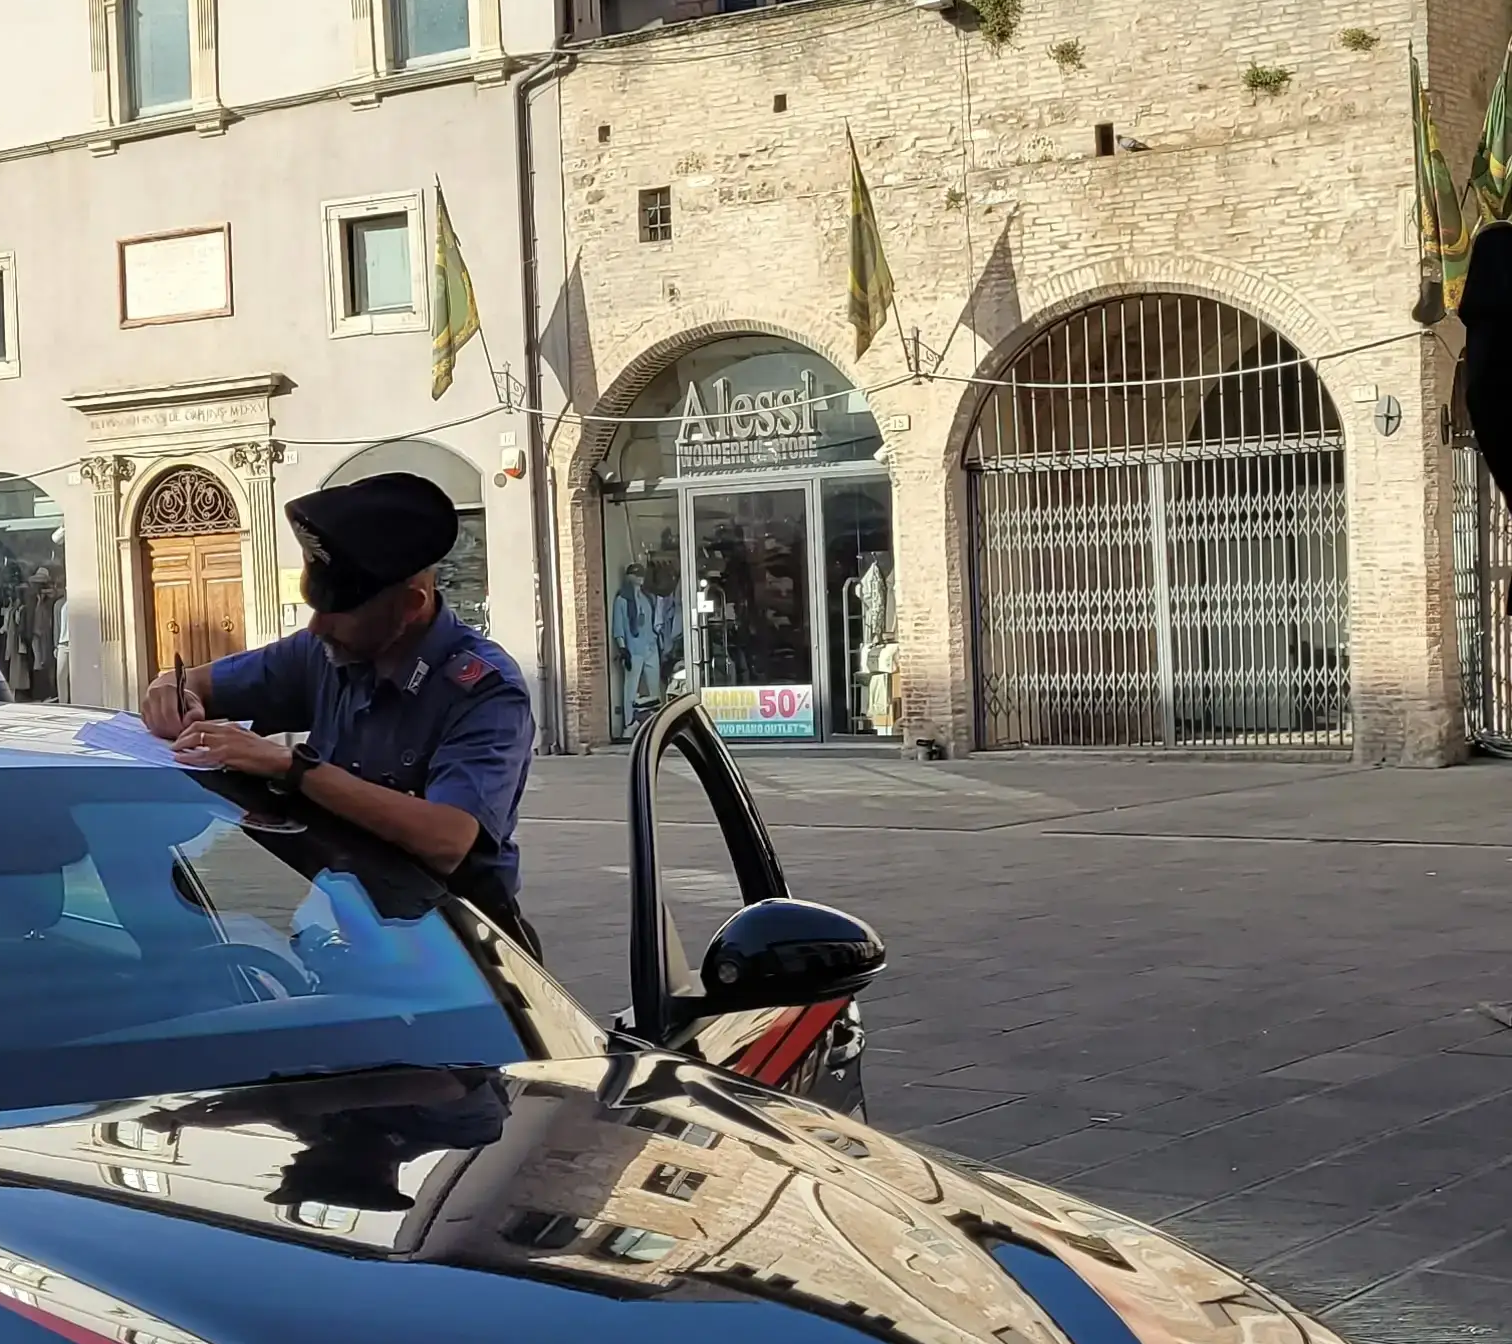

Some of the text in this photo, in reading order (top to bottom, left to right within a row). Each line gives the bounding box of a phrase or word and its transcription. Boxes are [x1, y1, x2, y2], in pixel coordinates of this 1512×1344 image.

[676, 369, 816, 444] Alessi
[679, 440, 768, 468] WONDERFUL
[759, 689, 810, 718] 50%
[764, 722, 798, 733] OUTLET
